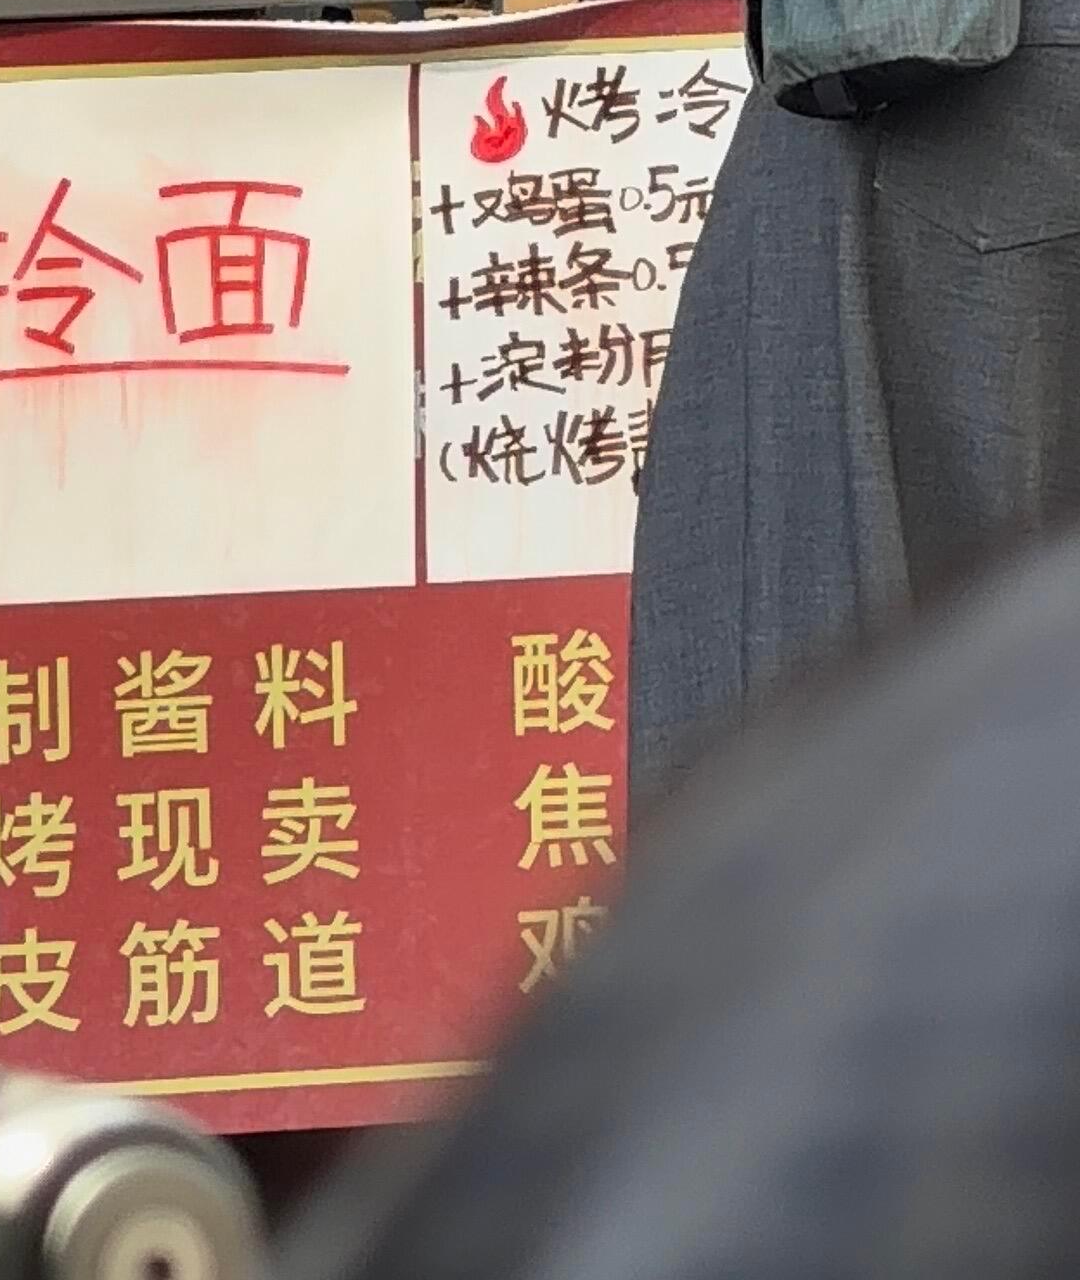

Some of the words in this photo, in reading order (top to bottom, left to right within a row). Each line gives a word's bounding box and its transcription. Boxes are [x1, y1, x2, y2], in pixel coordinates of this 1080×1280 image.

[542, 59, 748, 144] 烤冷
[511, 629, 615, 737] 酸
[515, 762, 616, 870] 焦
